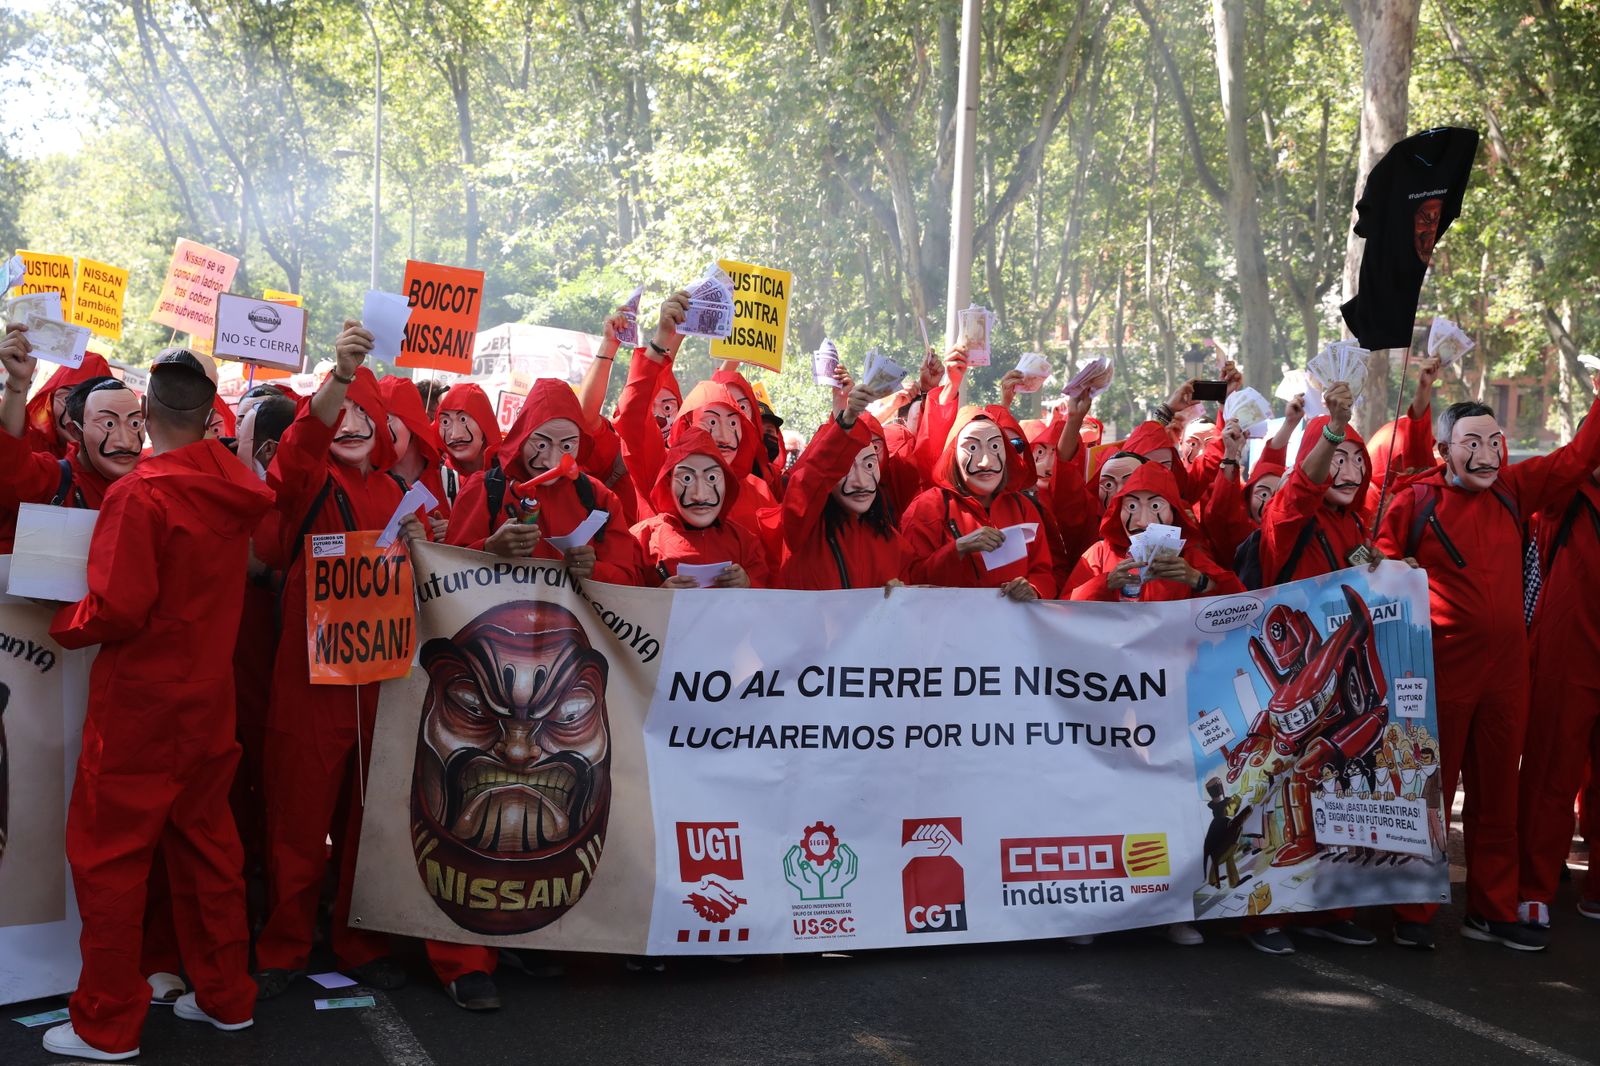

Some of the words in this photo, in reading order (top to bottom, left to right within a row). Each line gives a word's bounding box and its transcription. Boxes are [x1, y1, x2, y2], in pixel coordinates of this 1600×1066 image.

[184, 250, 207, 267] Nissan
[207, 260, 216, 271] se
[216, 264, 226, 275] va
[83, 267, 123, 288] NISSAN
[173, 268, 191, 281] como
[191, 272, 201, 284] un
[158, 301, 175, 313] gran
[174, 286, 188, 298] tras
[188, 289, 212, 306] cobrar
[407, 278, 479, 315] BOICOT
[74, 311, 84, 322] al
[86, 313, 120, 333] Japón!
[249, 314, 281, 325] NISSAN
[733, 299, 779, 326] ONTRA
[221, 332, 240, 344] NO
[243, 335, 256, 347] SE
[260, 338, 300, 354] CIERRA
[400, 322, 474, 360] NISSAN!
[723, 326, 778, 354] NISSAN!
[314, 555, 406, 602] BOICOT
[1204, 602, 1258, 619] SAYONARA
[1211, 613, 1249, 627] BABY!!!
[1330, 604, 1397, 629] NIAN
[314, 617, 411, 665] NISSAN!
[668, 670, 732, 702] NO
[740, 669, 786, 699] AL
[797, 665, 943, 699] CIERRE
[953, 665, 1002, 697] DE
[1014, 666, 1167, 702] NISSAN
[1396, 683, 1412, 691] PLAN
[1197, 716, 1220, 731] NISSAN
[1203, 729, 1212, 737] NO
[1211, 725, 1221, 733] SE
[668, 723, 895, 750] LUCHAREMOS
[904, 723, 962, 748] POR
[970, 722, 1016, 747] UN
[1025, 722, 1156, 748] FUTURO
[1328, 812, 1355, 823] EXIGIMOS
[1355, 814, 1365, 824] UN
[1366, 816, 1394, 828] FUTURO
[1395, 819, 1418, 831] REAL
[1369, 804, 1378, 813] DE
[1379, 805, 1421, 818] MENTIRAS!
[686, 827, 742, 861] UGT
[1009, 843, 1114, 873] CCOO
[425, 858, 584, 911] NISSAN
[1002, 880, 1125, 907] indústria
[1130, 883, 1170, 894] NISSAN
[793, 917, 855, 936] USOC
[908, 904, 962, 928] CGT
